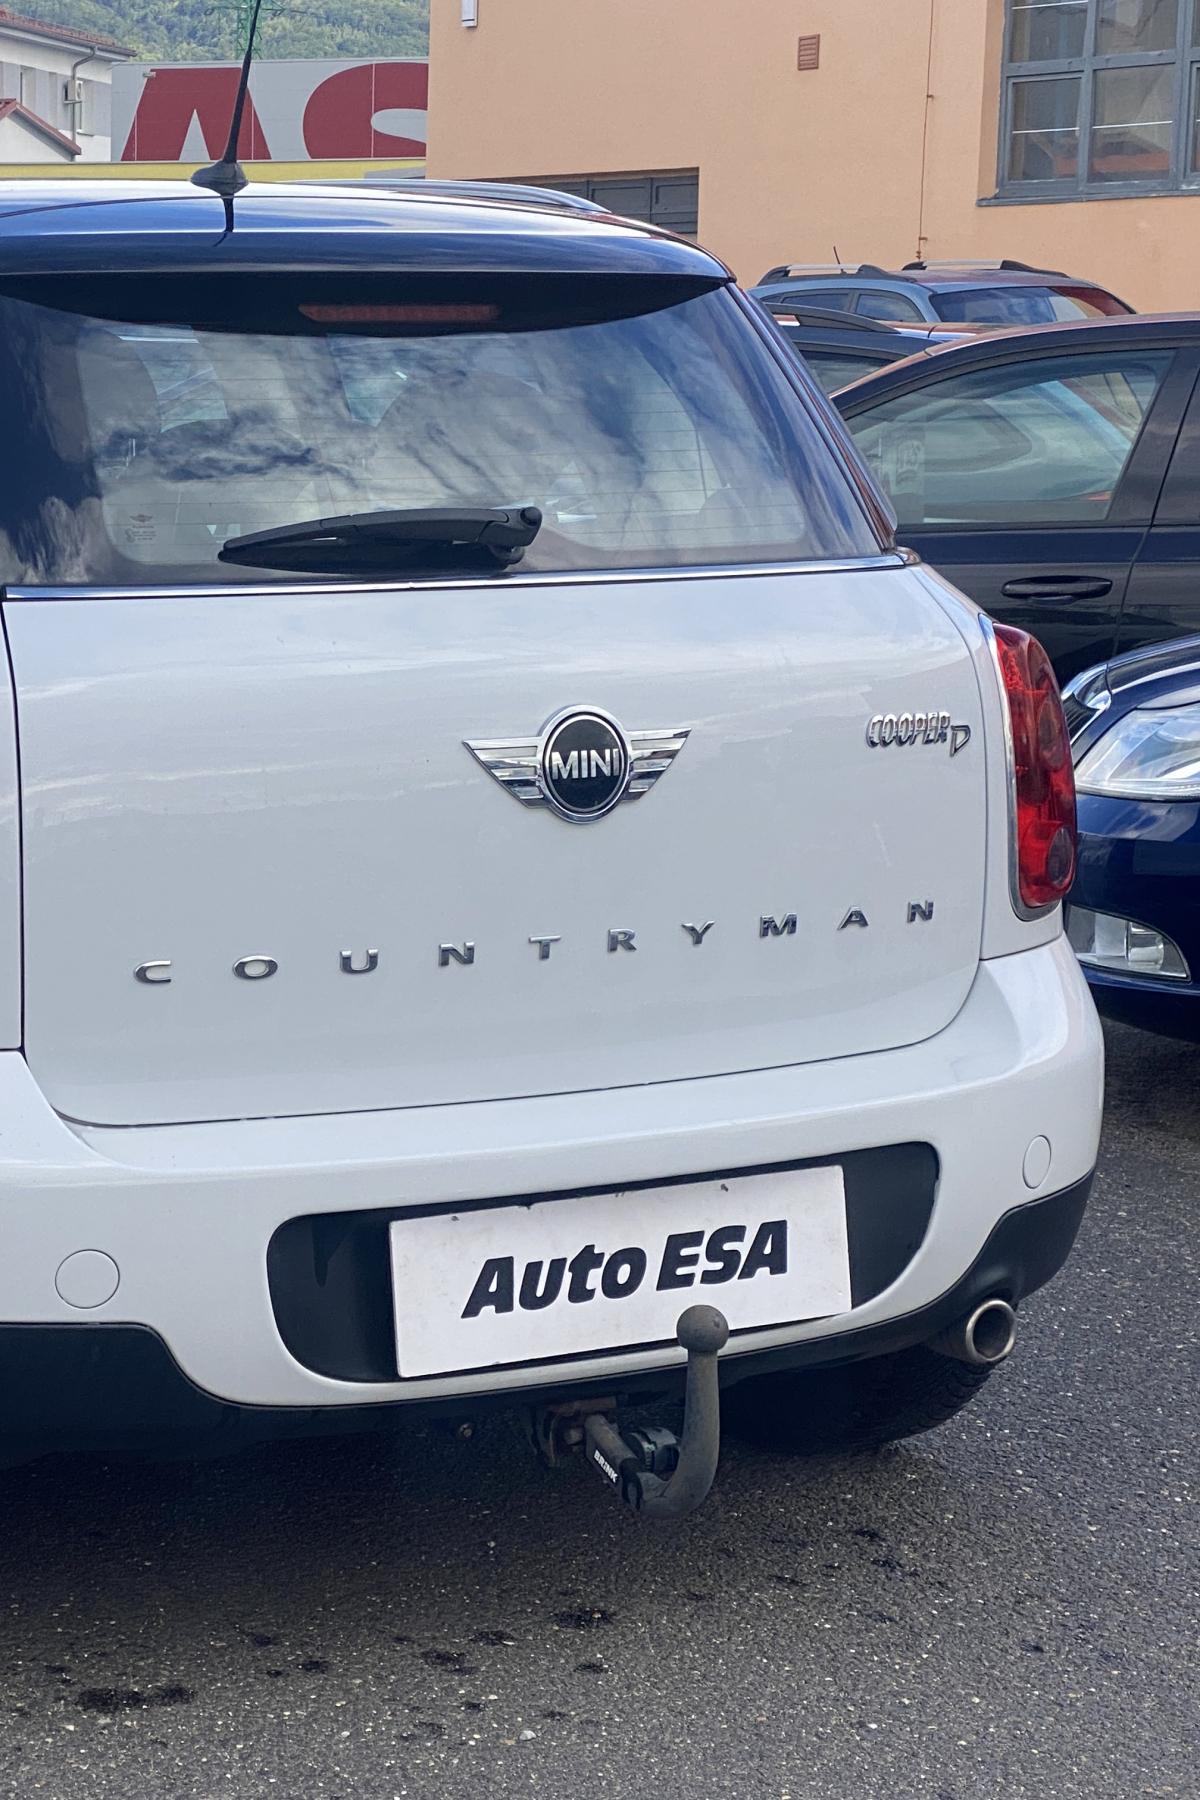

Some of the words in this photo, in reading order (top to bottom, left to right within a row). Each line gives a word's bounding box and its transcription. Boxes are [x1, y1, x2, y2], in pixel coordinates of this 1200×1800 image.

[551, 748, 620, 780] MINI
[866, 711, 951, 748] COOPER
[949, 724, 971, 758] D
[133, 899, 934, 985] COUNTRYMAN
[460, 1244, 648, 1319] Auto
[655, 1219, 788, 1291] ESA
